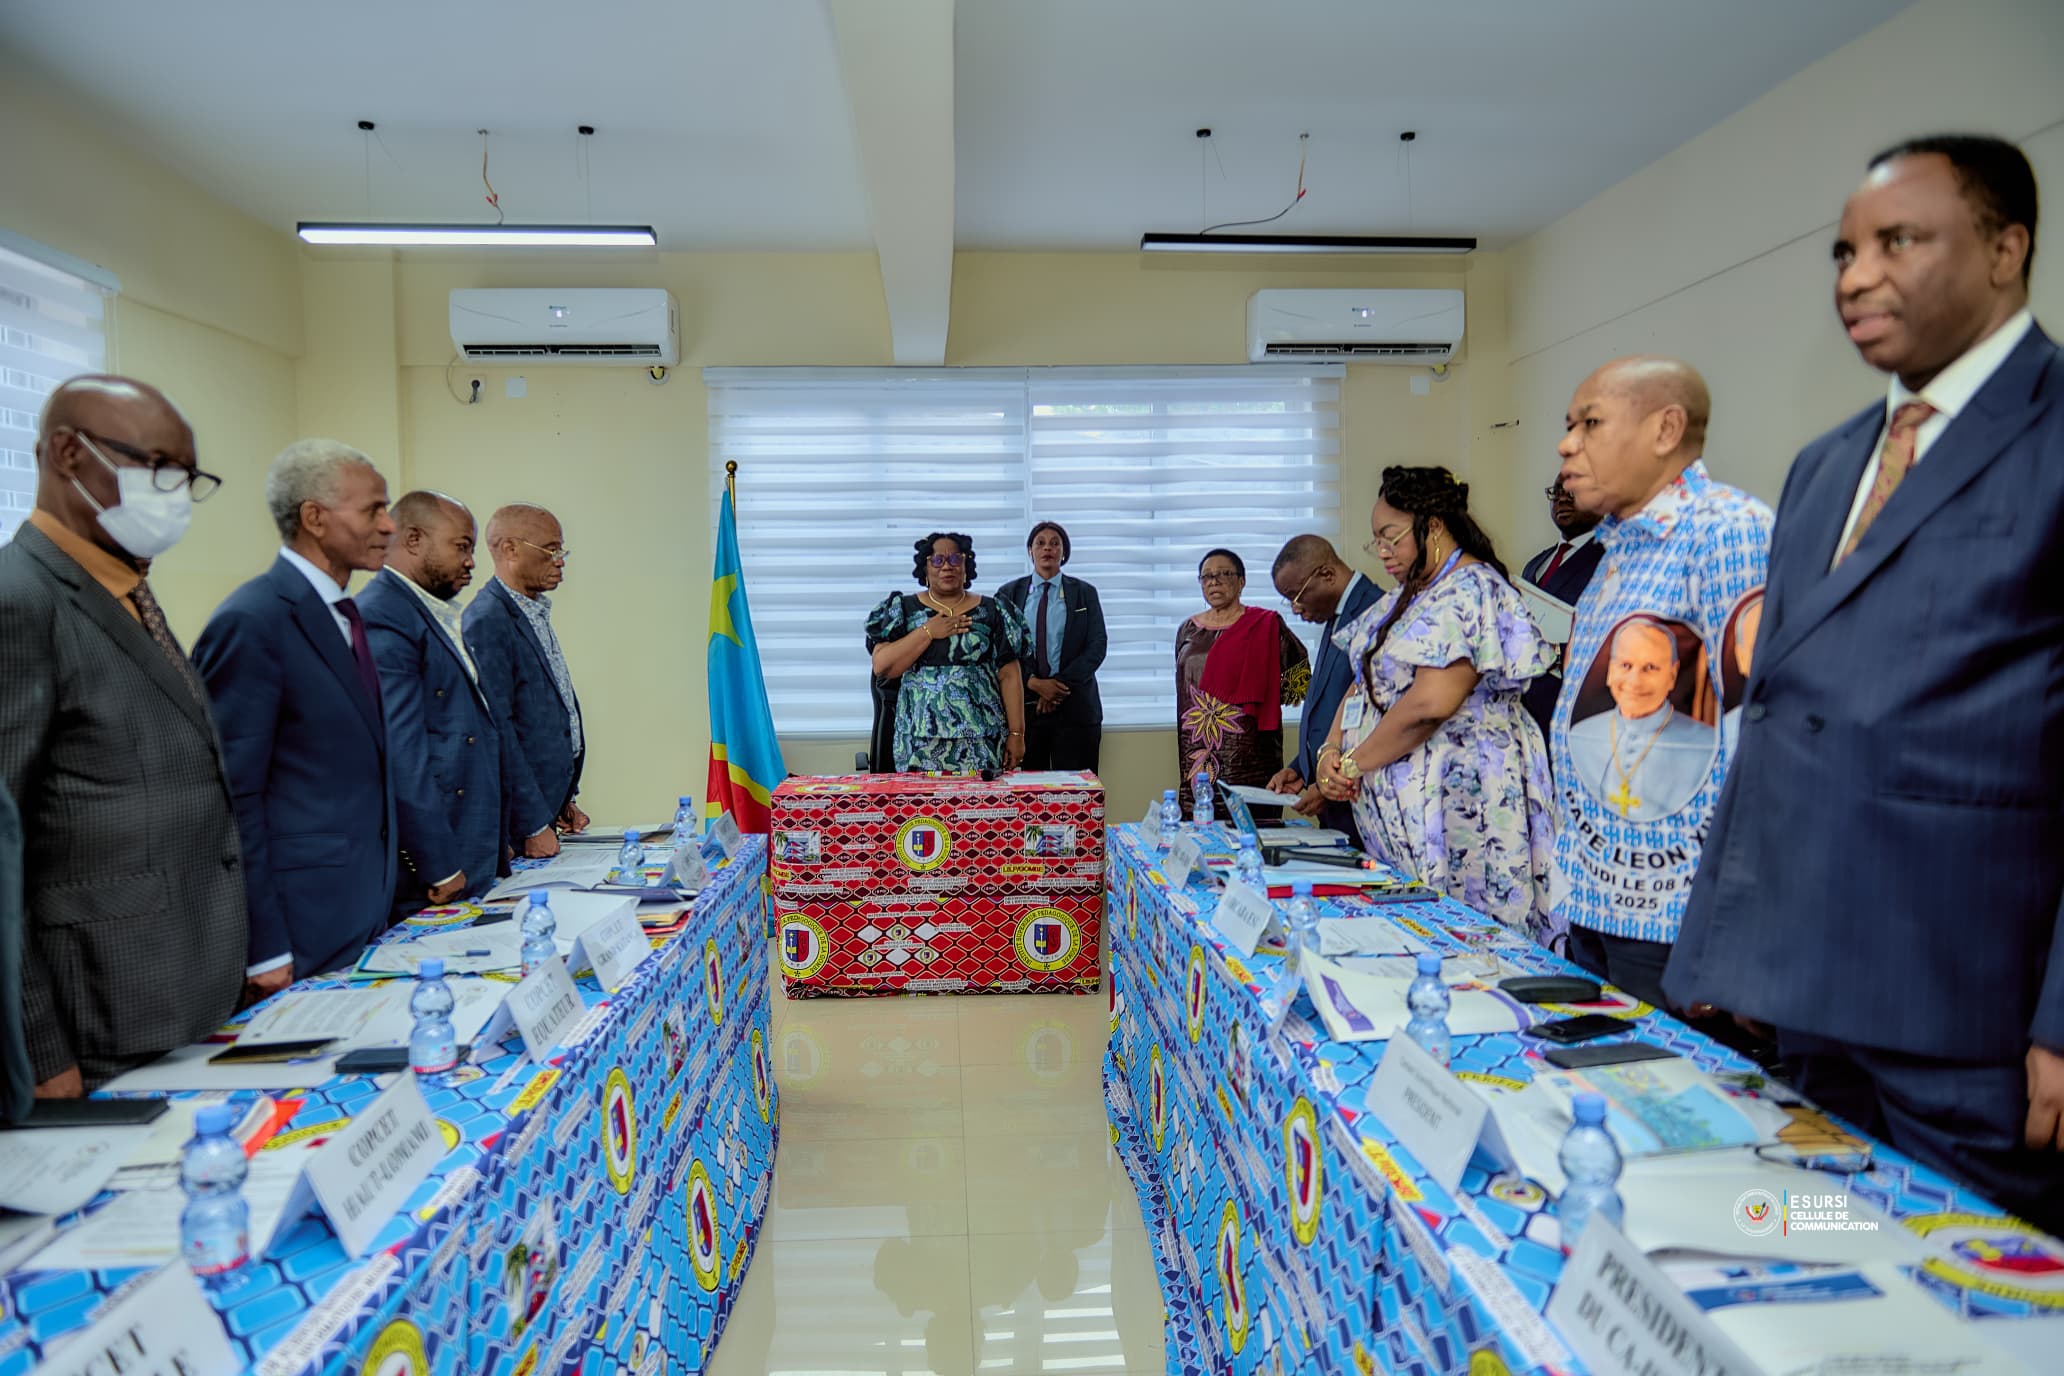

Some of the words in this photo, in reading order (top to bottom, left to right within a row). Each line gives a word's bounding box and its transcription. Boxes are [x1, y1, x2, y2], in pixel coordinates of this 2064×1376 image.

[1566, 790, 1607, 853] PAPE
[1613, 846, 1687, 870] LEON
[1578, 851, 1616, 885] JEUDI
[1623, 878, 1646, 892] LE
[1653, 879, 1676, 892] 08
[1614, 893, 1658, 910] 2025
[531, 993, 576, 1046] EQUATEUR
[348, 1108, 400, 1168] COPCET
